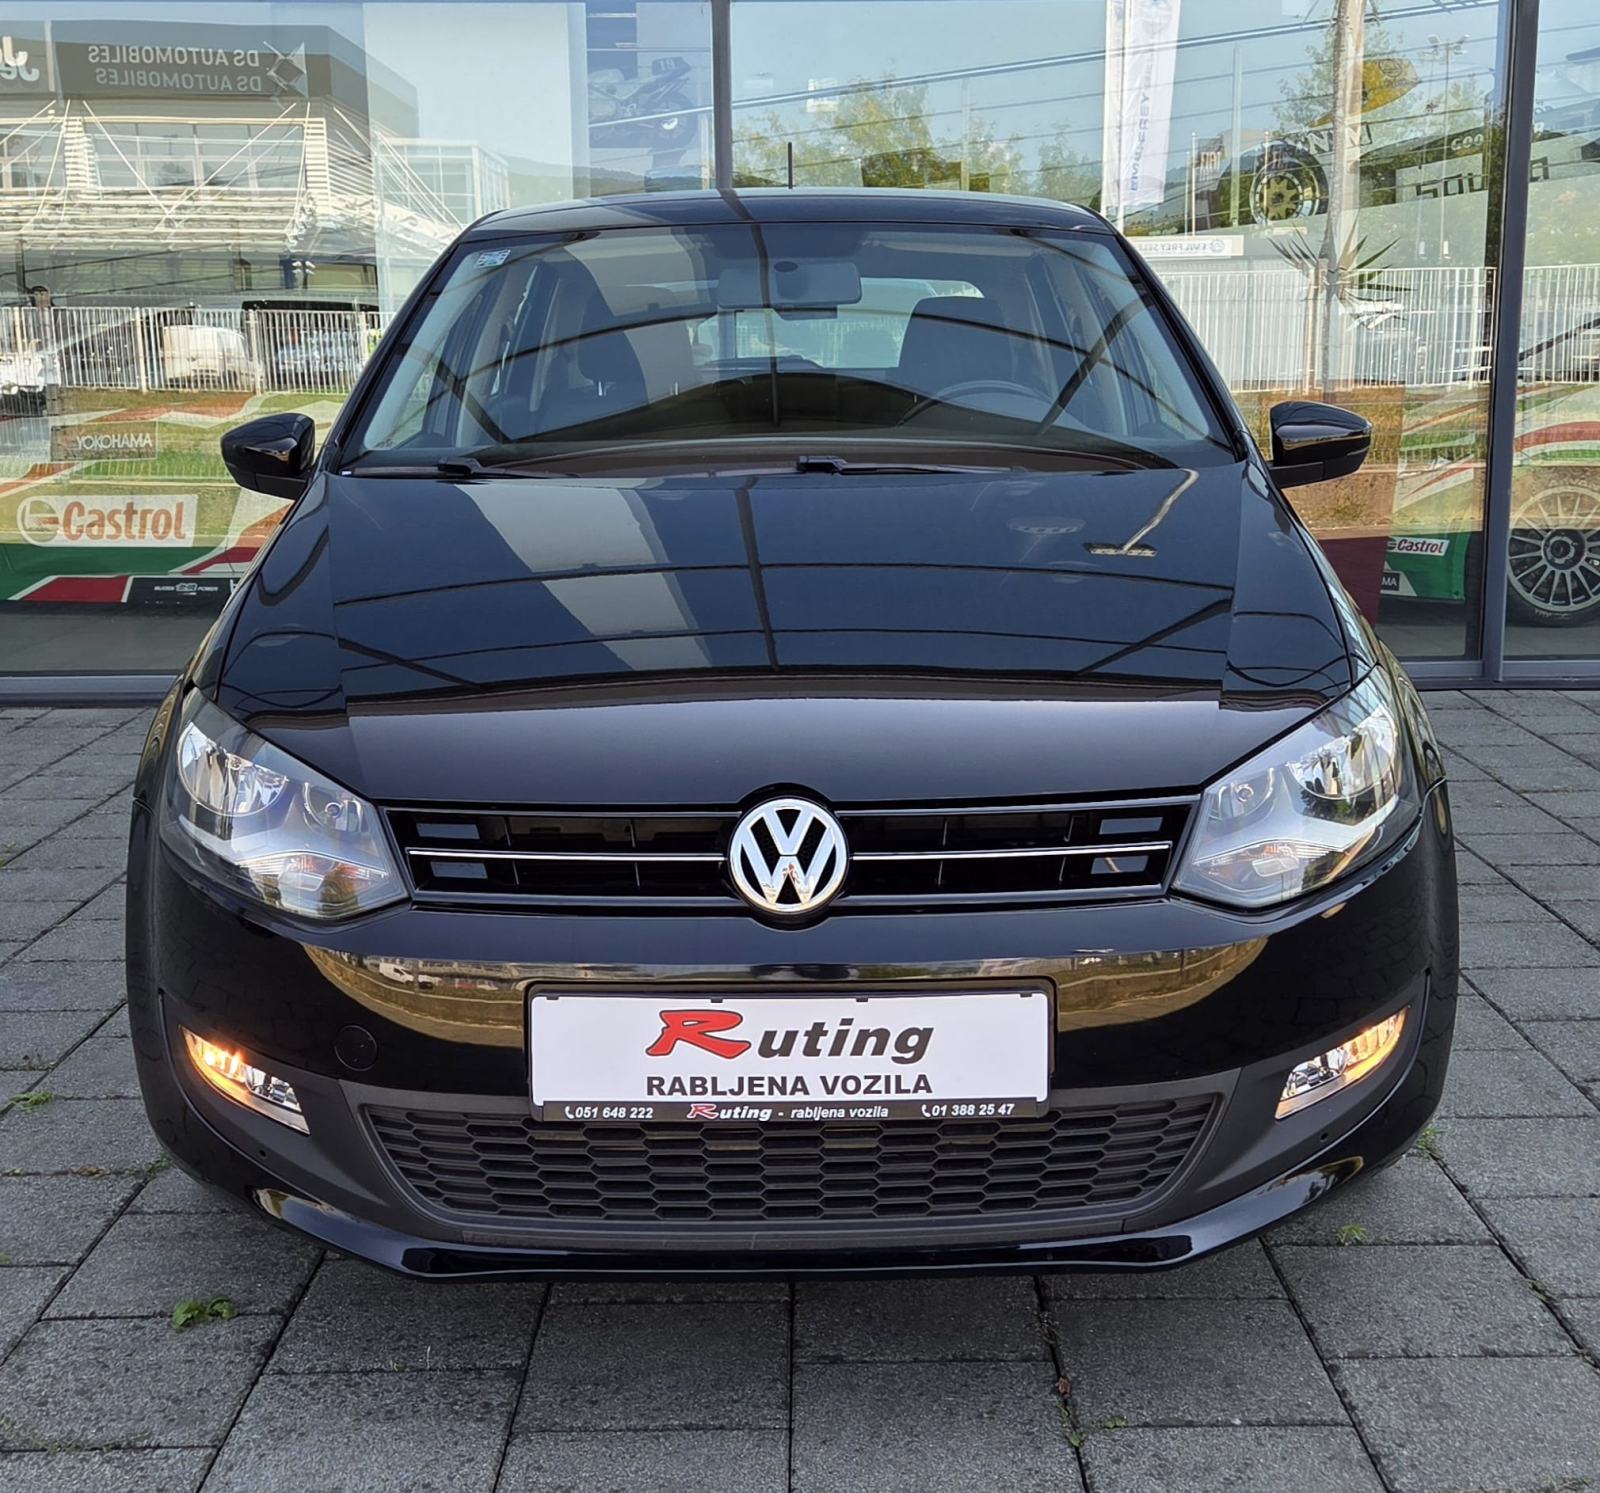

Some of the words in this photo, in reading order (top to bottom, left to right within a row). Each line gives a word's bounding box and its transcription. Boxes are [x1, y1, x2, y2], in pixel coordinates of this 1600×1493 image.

[75, 432, 153, 450] YOKOHAMA
[62, 501, 187, 541] Castrol
[1397, 538, 1445, 554] Castrol
[645, 1009, 934, 1065] Ruting
[646, 1075, 810, 1096] RABLJENA
[819, 1074, 933, 1095] VOZILA
[575, 1106, 598, 1119] 051
[602, 1107, 627, 1119] 648
[630, 1107, 654, 1119] 222
[686, 1103, 773, 1122] Ruting
[790, 1105, 845, 1121] rabljena
[848, 1106, 889, 1119] vozila
[931, 1105, 947, 1117] 01
[951, 1104, 975, 1116] 388
[978, 1103, 995, 1116] 25
[997, 1103, 1015, 1116] 47
